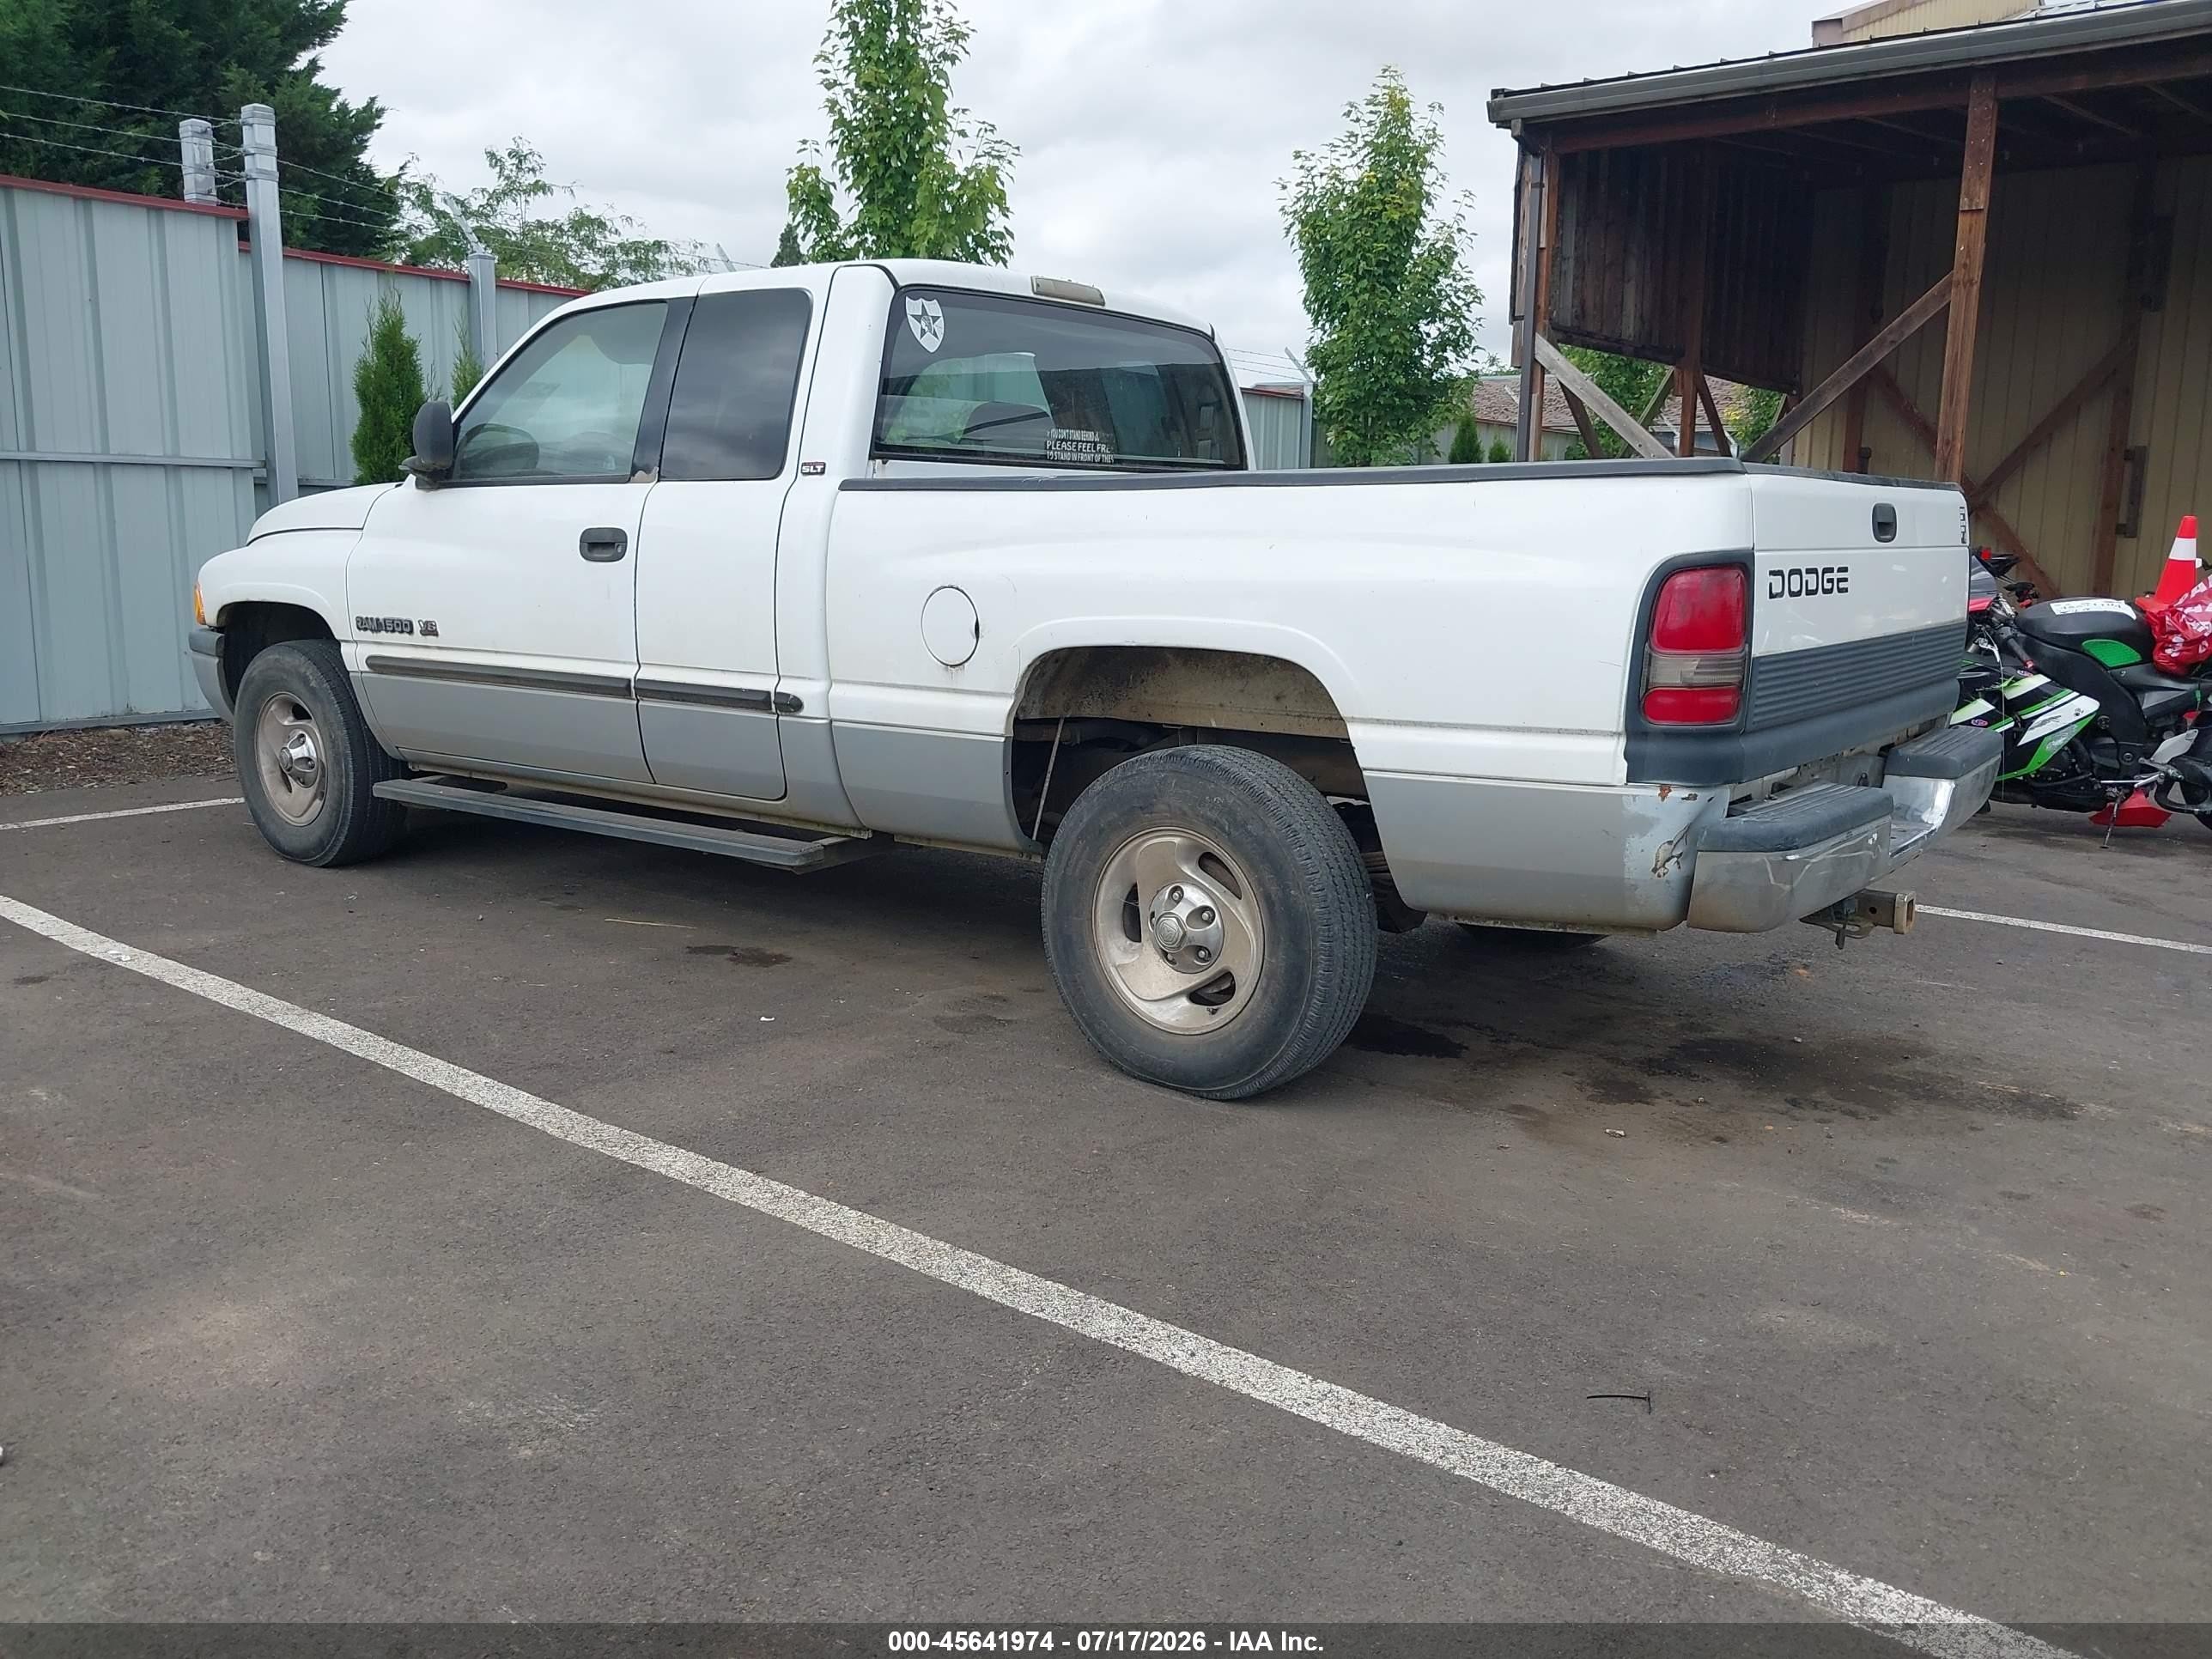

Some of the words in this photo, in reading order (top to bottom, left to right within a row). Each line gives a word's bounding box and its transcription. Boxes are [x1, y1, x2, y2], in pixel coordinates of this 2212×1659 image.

[1047, 441, 1077, 452] PLEASE
[1078, 442, 1096, 453] FEEL
[1047, 451, 1054, 460] TO
[1054, 452, 1071, 461] STAND
[1072, 453, 1078, 461] IN
[1078, 453, 1094, 462] FRONT
[1094, 453, 1101, 462] OF
[801, 465, 824, 473] SLT
[1768, 566, 1849, 599] DODGE
[356, 617, 378, 633] RAM
[380, 617, 412, 634] 1500
